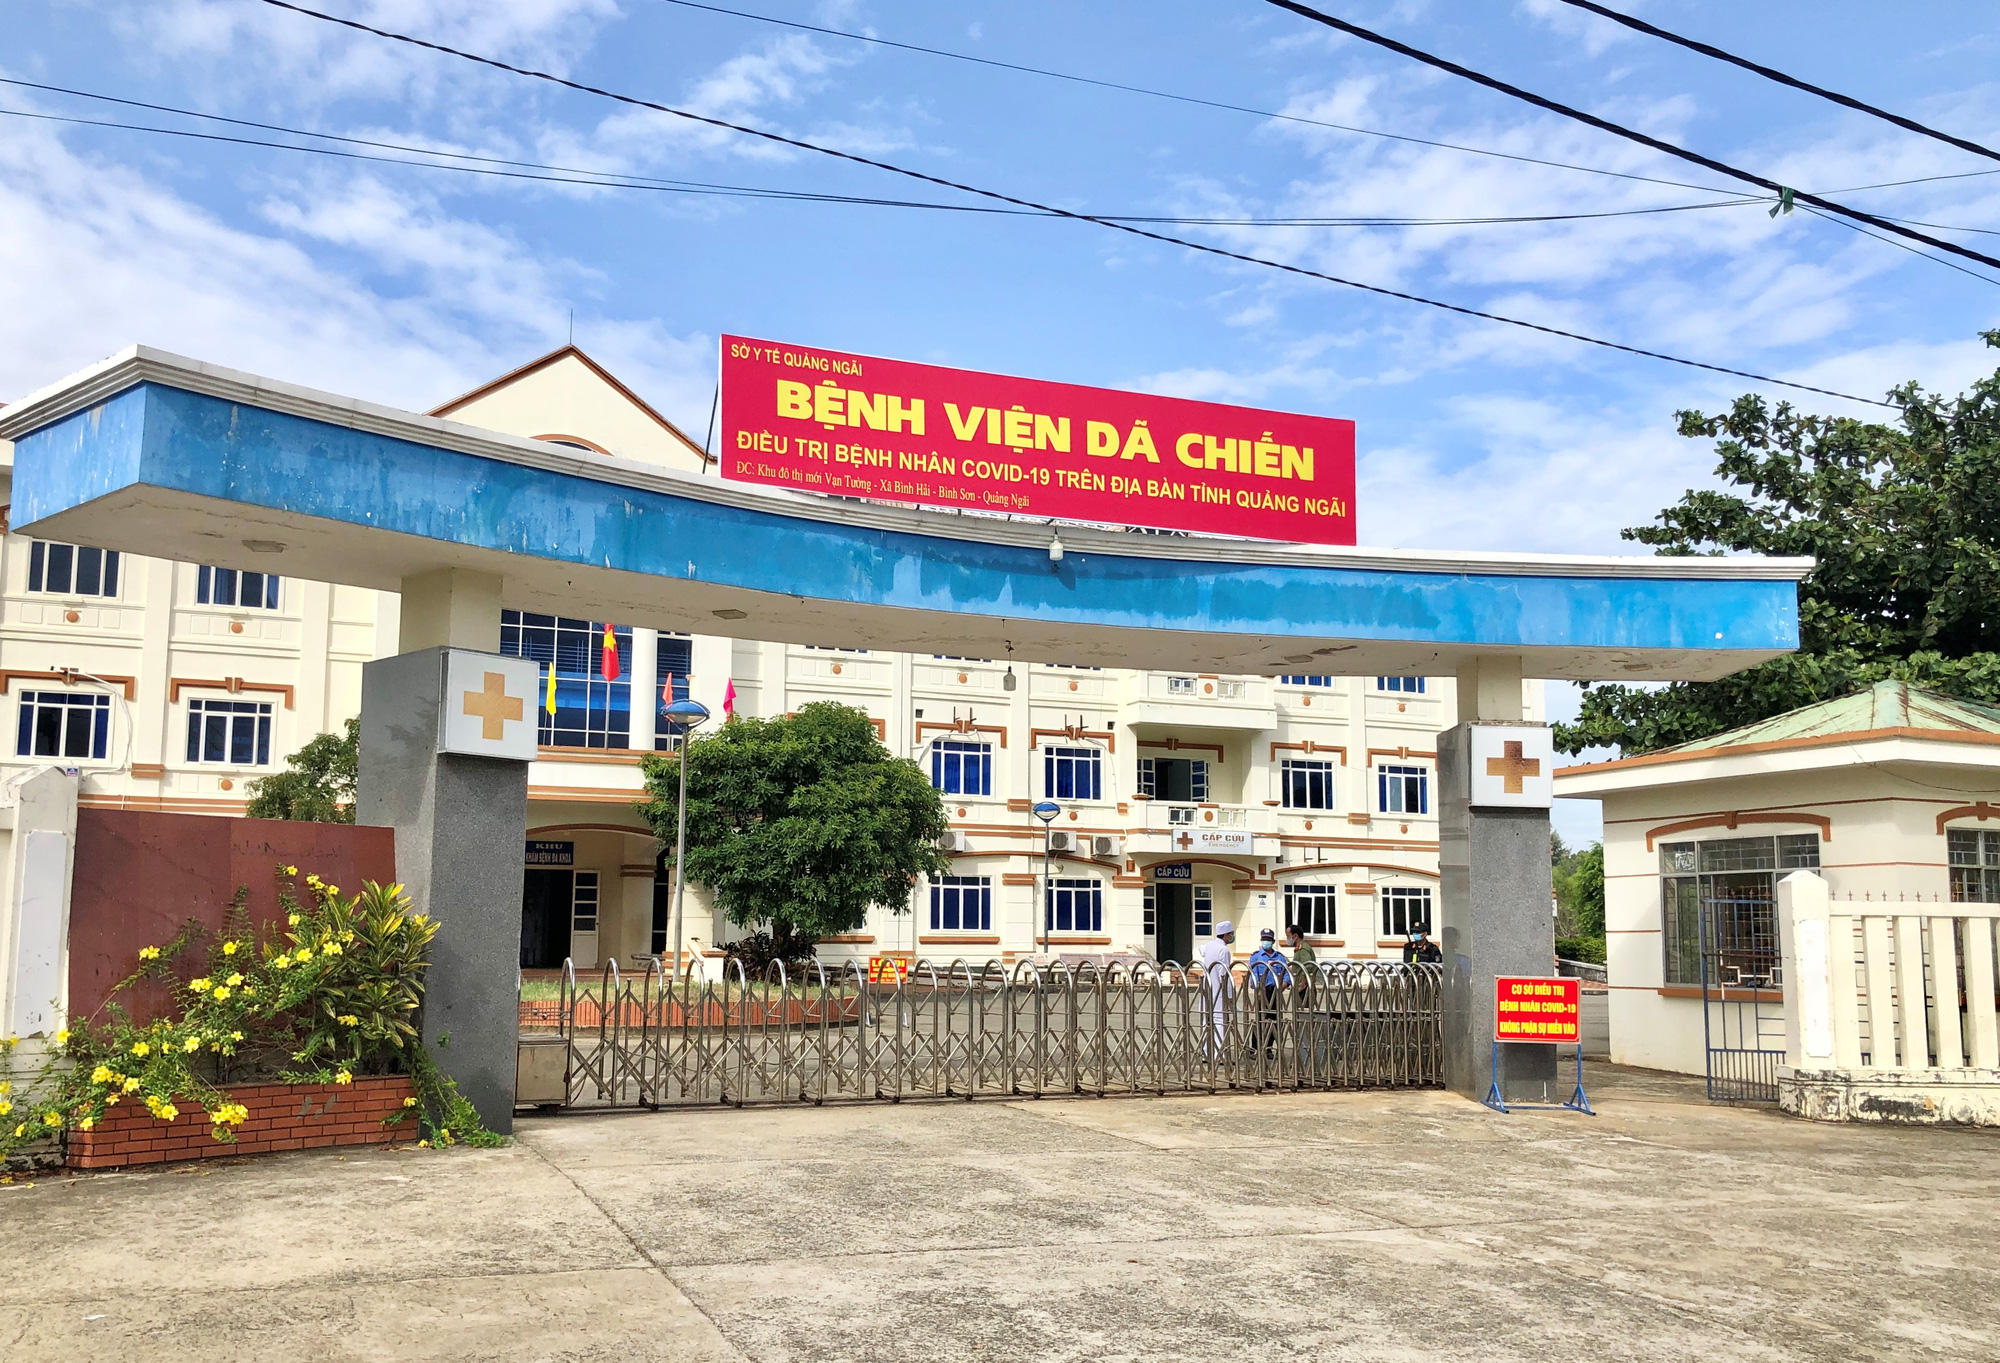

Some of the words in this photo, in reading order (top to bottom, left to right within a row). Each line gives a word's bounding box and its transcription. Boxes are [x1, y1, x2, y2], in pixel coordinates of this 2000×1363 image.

[731, 342, 751, 359] SỞ
[753, 347, 762, 360] Y
[764, 348, 781, 364] TẾ
[783, 352, 829, 372] QUẢNG
[832, 359, 862, 377] NGÃI
[777, 379, 925, 436] BỆNH
[943, 402, 1071, 454] VIỆN
[1086, 419, 1161, 464] DÃ
[1175, 431, 1314, 482] CHIẾN
[736, 429, 788, 455] ĐIỀU
[794, 438, 828, 465] TRỊ
[835, 443, 893, 469] BỆNH
[899, 451, 956, 476] NHÂN
[961, 459, 1050, 486] COVID-19
[1055, 468, 1106, 492] TRÊN
[1110, 476, 1143, 499] ĐỊA
[1147, 477, 1185, 500] BÀN
[1189, 482, 1231, 505] TỈNH
[1236, 489, 1300, 513] QUẢNG
[1304, 497, 1346, 518] NGÃI
[736, 461, 755, 474] ĐC:
[757, 463, 776, 478] Khu
[778, 466, 790, 480] đô
[791, 468, 803, 484] thị
[805, 471, 822, 484] mới
[825, 472, 842, 488] Vạn
[844, 474, 872, 493] Tường
[879, 478, 893, 493] Xã
[894, 478, 914, 495] Bình
[916, 482, 931, 497] Hải
[938, 484, 958, 500] Bình
[960, 488, 976, 502] Sơn
[982, 490, 1009, 508] Quảng
[1010, 493, 1030, 509] Ngãi
[1157, 866, 1172, 877] CẤP
[1173, 866, 1190, 878] CỨU
[1511, 984, 1522, 995] CƠ
[1523, 982, 1533, 995] SỞ
[1552, 985, 1565, 998] TRỊ
[1499, 999, 1519, 1014] BỆNH
[1520, 999, 1540, 1012] NHÂN
[1541, 1002, 1576, 1013] COVID-19
[1499, 1019, 1520, 1033] KHÔNG
